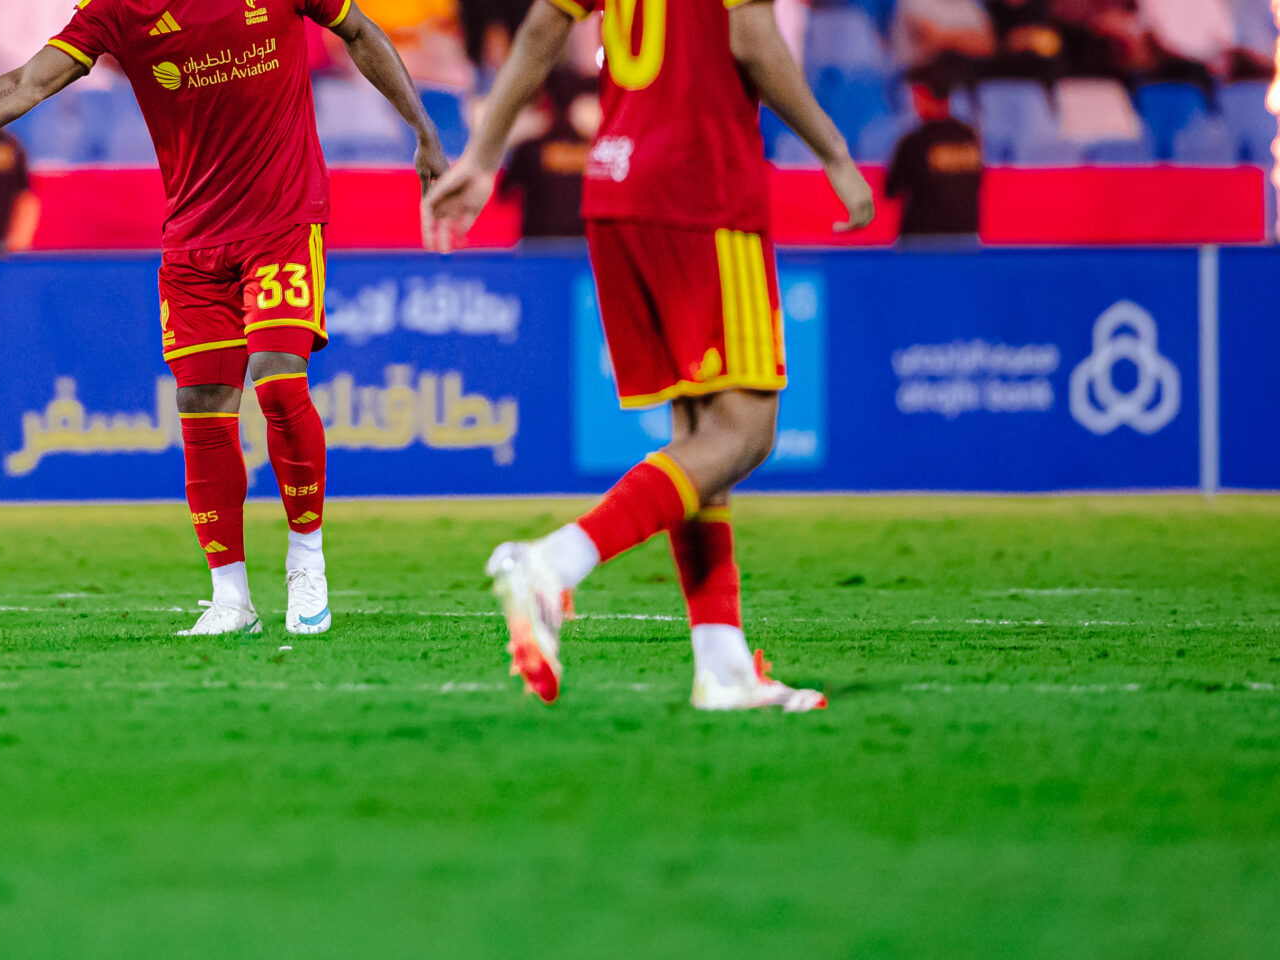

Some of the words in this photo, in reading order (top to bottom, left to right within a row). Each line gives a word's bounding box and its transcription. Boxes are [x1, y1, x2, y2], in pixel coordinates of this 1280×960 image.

[183, 48, 232, 74] للطيران
[187, 69, 229, 88] Aloula
[230, 58, 280, 81] Aviation
[255, 262, 310, 309] 33
[284, 482, 319, 496] 1935
